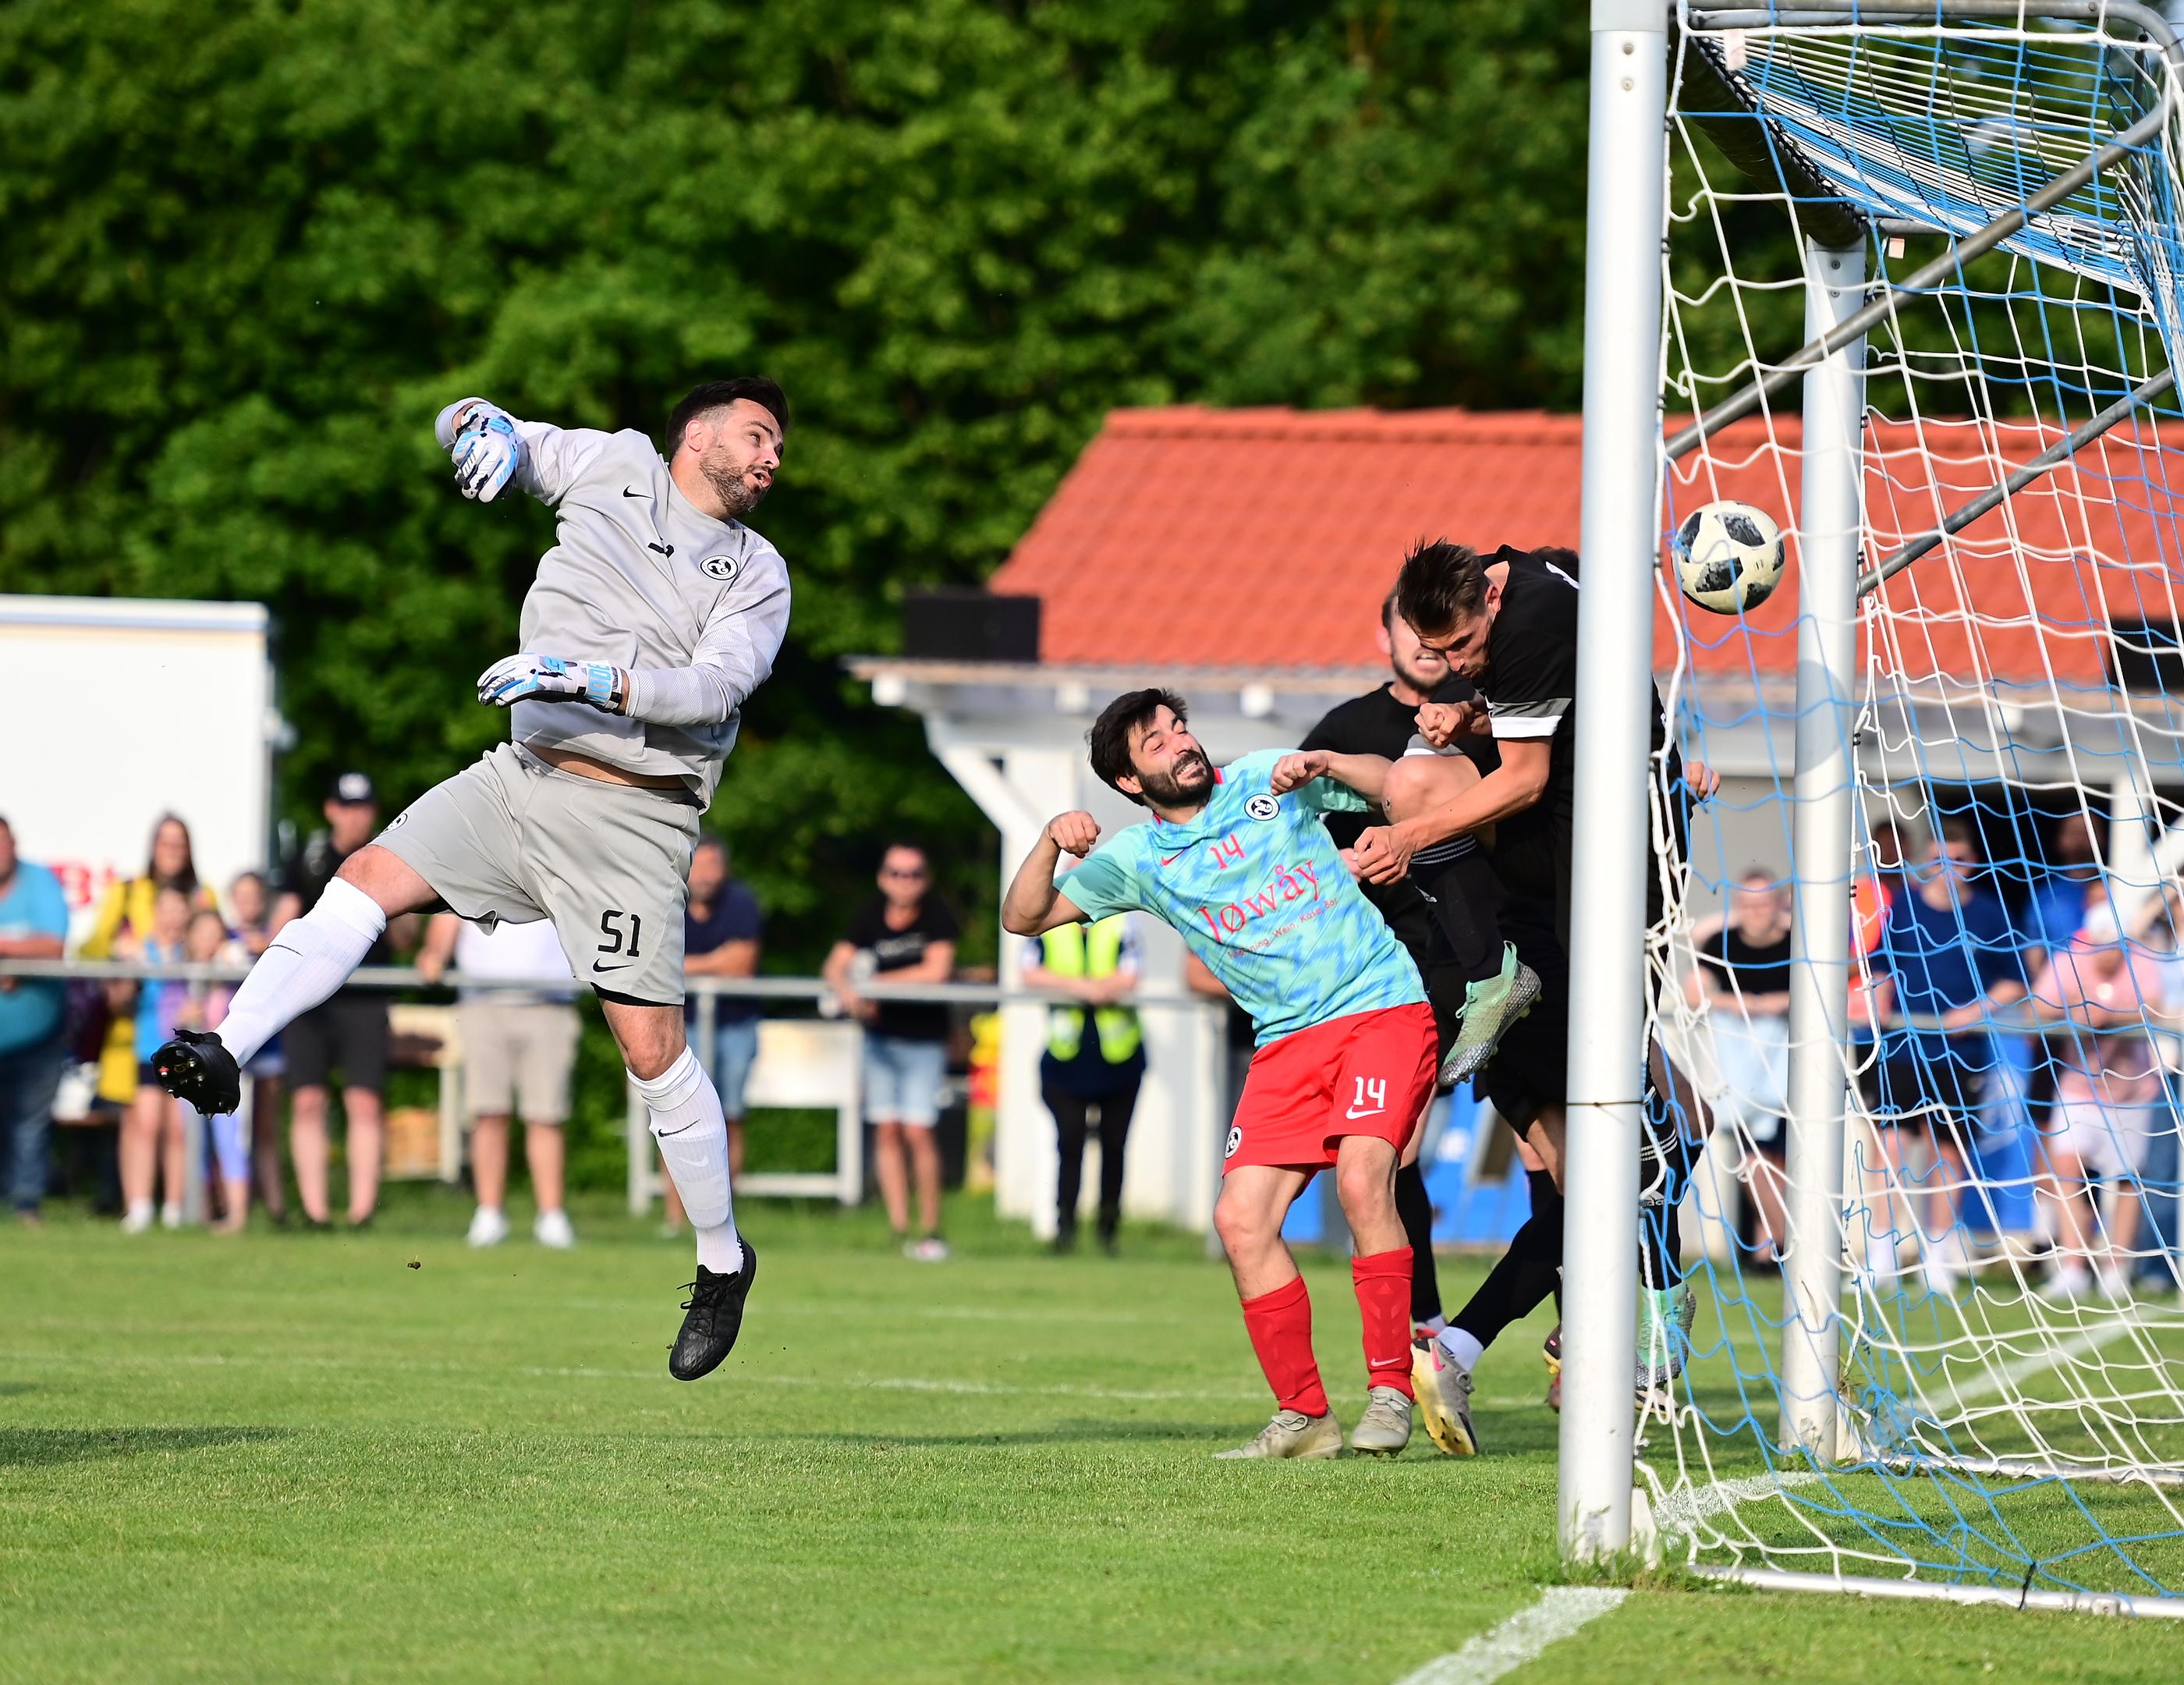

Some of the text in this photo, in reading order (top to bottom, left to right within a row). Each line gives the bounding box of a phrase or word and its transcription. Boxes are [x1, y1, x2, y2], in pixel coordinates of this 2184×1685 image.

[1210, 833, 1246, 870] 14
[597, 909, 641, 958] 51
[1353, 1076, 1386, 1109] 14
